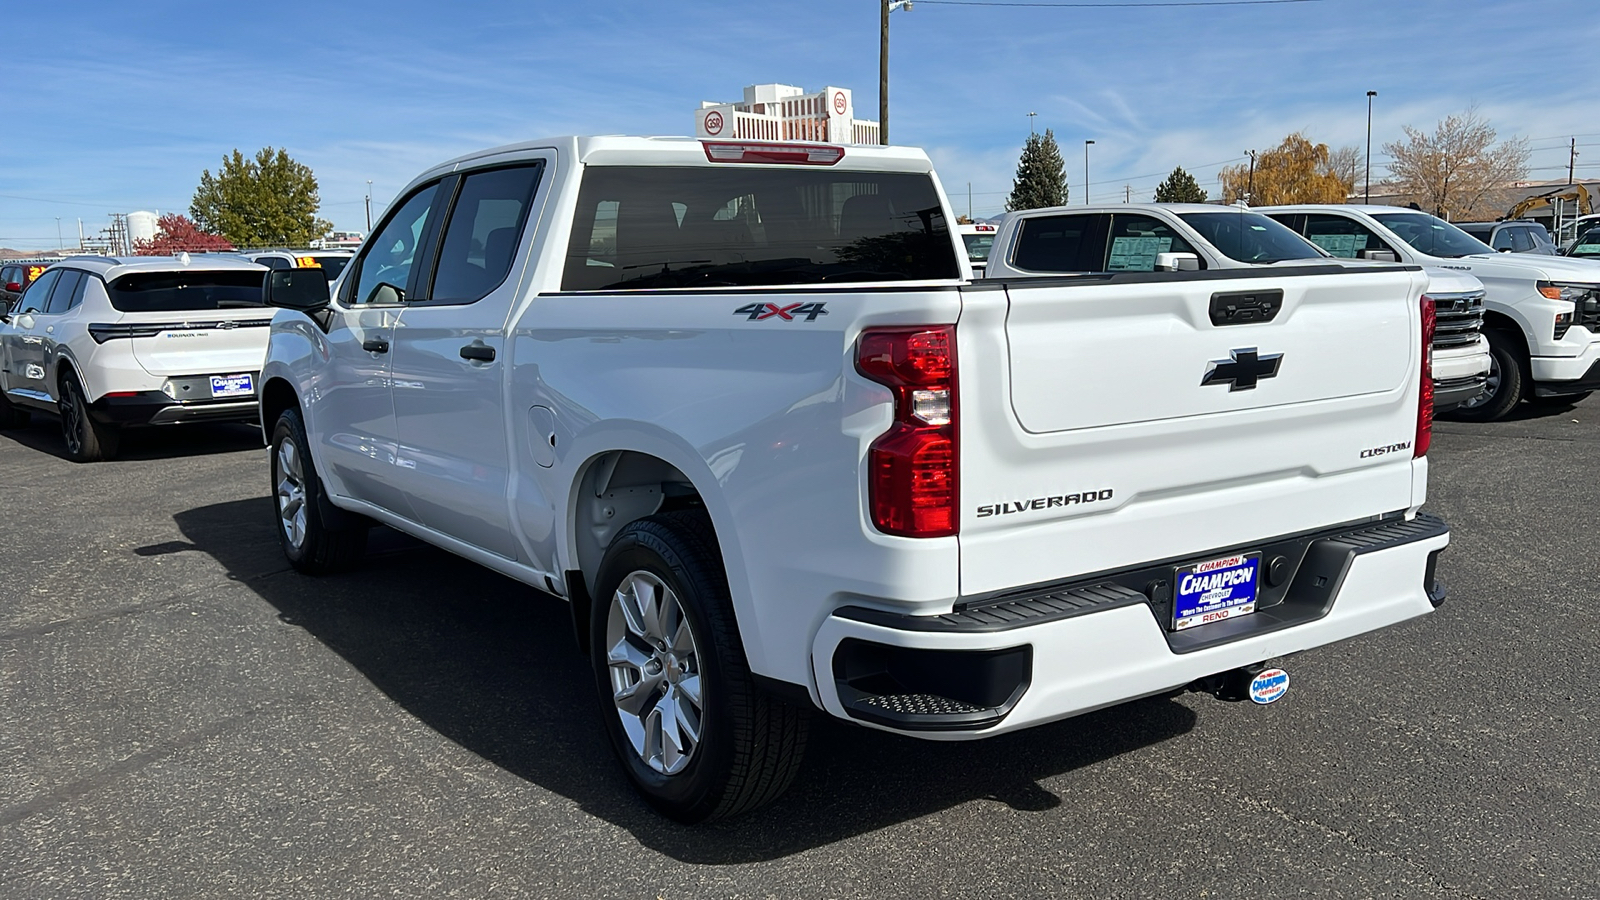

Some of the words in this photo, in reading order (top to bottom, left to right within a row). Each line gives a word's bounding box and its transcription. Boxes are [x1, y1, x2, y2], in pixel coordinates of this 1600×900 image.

[707, 117, 721, 128] GSR
[213, 378, 249, 386] CHAMPION
[1360, 441, 1411, 458] CUSTOM
[977, 489, 1113, 518] SILVERADO
[1199, 557, 1240, 572] CHAMPION
[1180, 566, 1254, 596] CHAMPION
[1201, 590, 1230, 601] CHEVROLET
[1202, 610, 1229, 622] RENO
